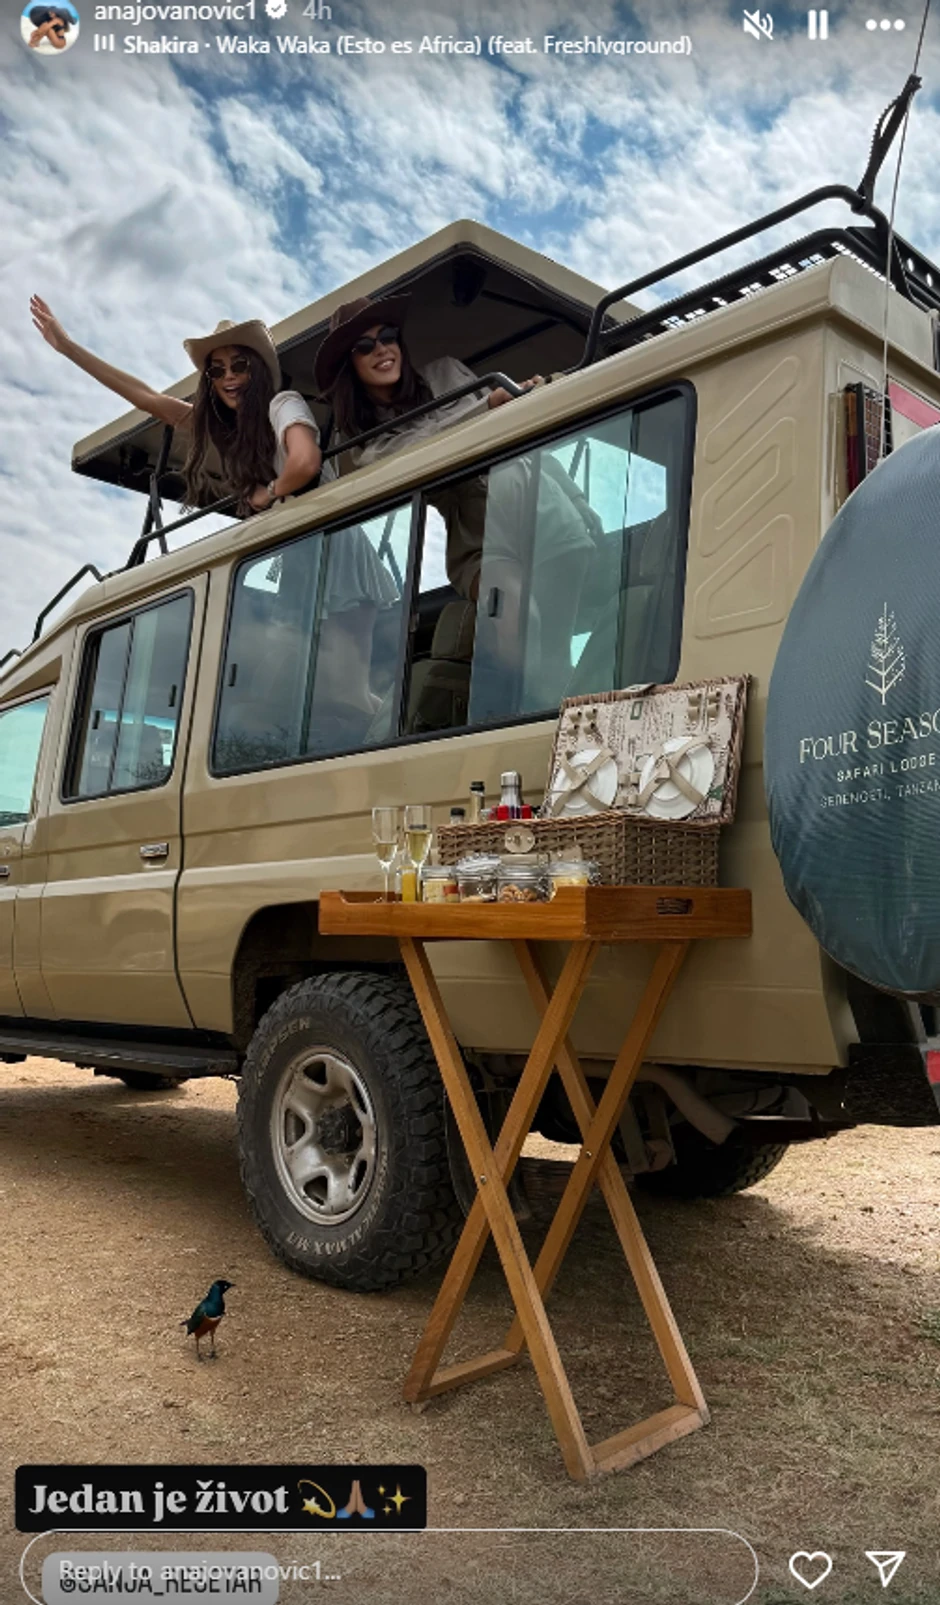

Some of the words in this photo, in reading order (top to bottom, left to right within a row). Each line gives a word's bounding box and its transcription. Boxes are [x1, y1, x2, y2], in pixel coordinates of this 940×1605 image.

[799, 730, 859, 764] FOUR
[836, 763, 884, 783] SAFARI
[890, 752, 936, 774] LODGE
